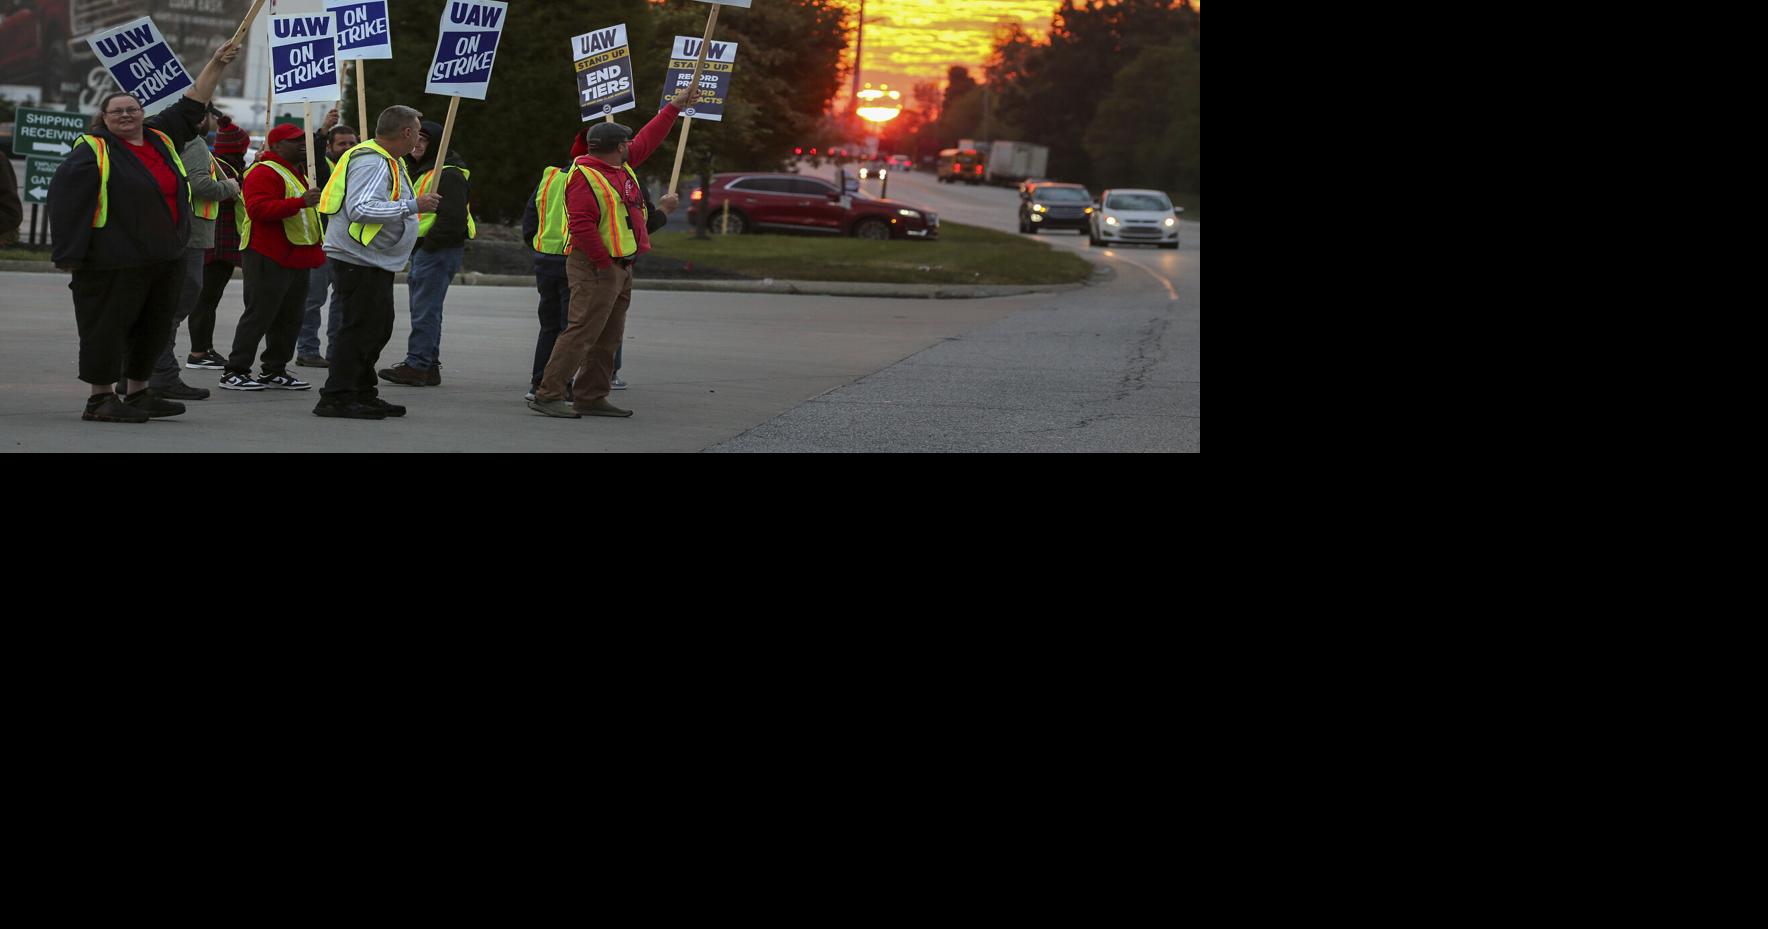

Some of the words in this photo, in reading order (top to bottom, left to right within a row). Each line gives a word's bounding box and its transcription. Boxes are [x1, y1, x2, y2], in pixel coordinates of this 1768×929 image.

[343, 5, 367, 26] ON
[450, 2, 503, 28] UAW
[273, 16, 330, 39] UAW
[96, 23, 155, 58] UAW
[455, 33, 481, 56] ON
[580, 28, 617, 55] UAW
[289, 43, 314, 66] ON
[432, 50, 494, 81] STRIKE
[578, 54, 609, 70] STAND
[611, 49, 625, 59] UP
[129, 53, 156, 80] ON
[274, 55, 336, 92] STRIKE
[586, 64, 622, 87] END
[673, 61, 710, 70] STAD
[713, 64, 729, 72] UP
[581, 76, 630, 102] TIERS
[664, 94, 724, 104] COACTS
[25, 113, 84, 129] SHIPPING
[30, 175, 53, 185] GAT
